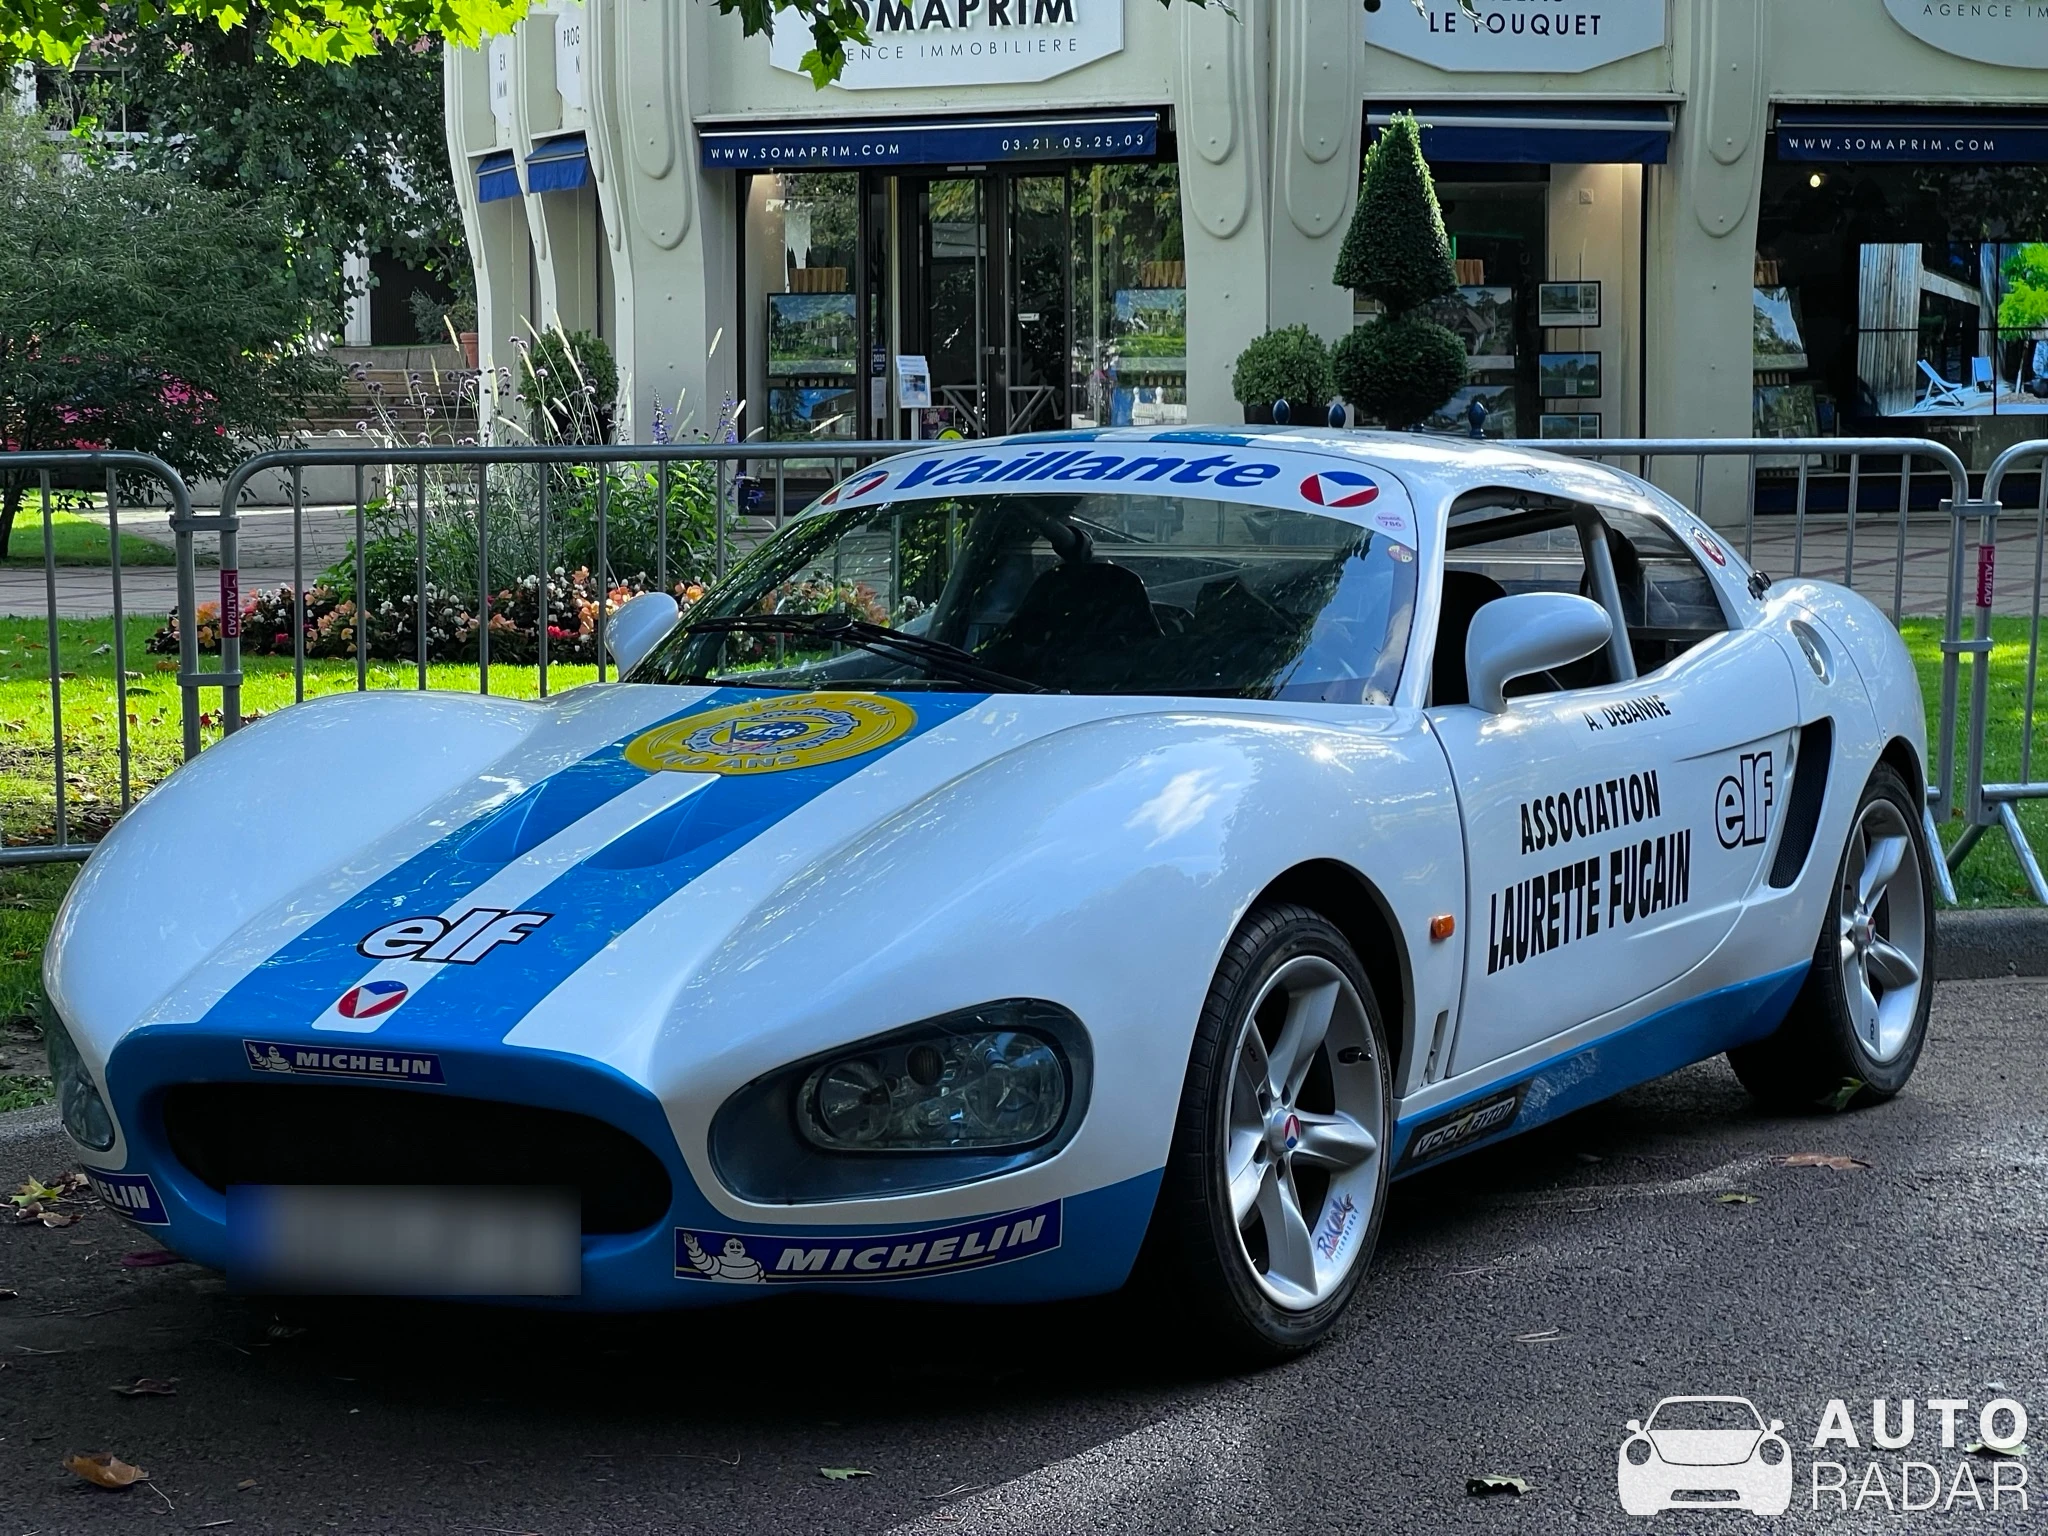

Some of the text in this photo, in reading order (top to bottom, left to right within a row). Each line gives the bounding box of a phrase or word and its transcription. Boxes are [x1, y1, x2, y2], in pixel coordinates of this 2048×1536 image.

[1429, 12, 1601, 36] LE TOUQUET
[1923, 4, 2012, 18] AGENCE
[920, 38, 1078, 57] IMMOBILIERE
[711, 134, 1144, 160] WWW.SOMAPRIM.COM 03.21.05.25.03
[1788, 138, 1995, 151] WWW.SOMAPRIM.COM
[893, 450, 1281, 491] Vaillante
[1984, 563, 1993, 605] ALTRAD
[226, 590, 237, 636] ALTRAD
[1582, 695, 1672, 731] A. DEBANNE
[652, 750, 800, 769] 100 ANS
[1520, 769, 1661, 855] ASSOCIATION
[1715, 751, 1774, 850] elf
[1487, 829, 1691, 976] LAURETTE FUGAIN
[356, 907, 556, 965] elf
[296, 1052, 431, 1075] MICHELIN
[776, 1215, 1046, 1272] MICHELIN
